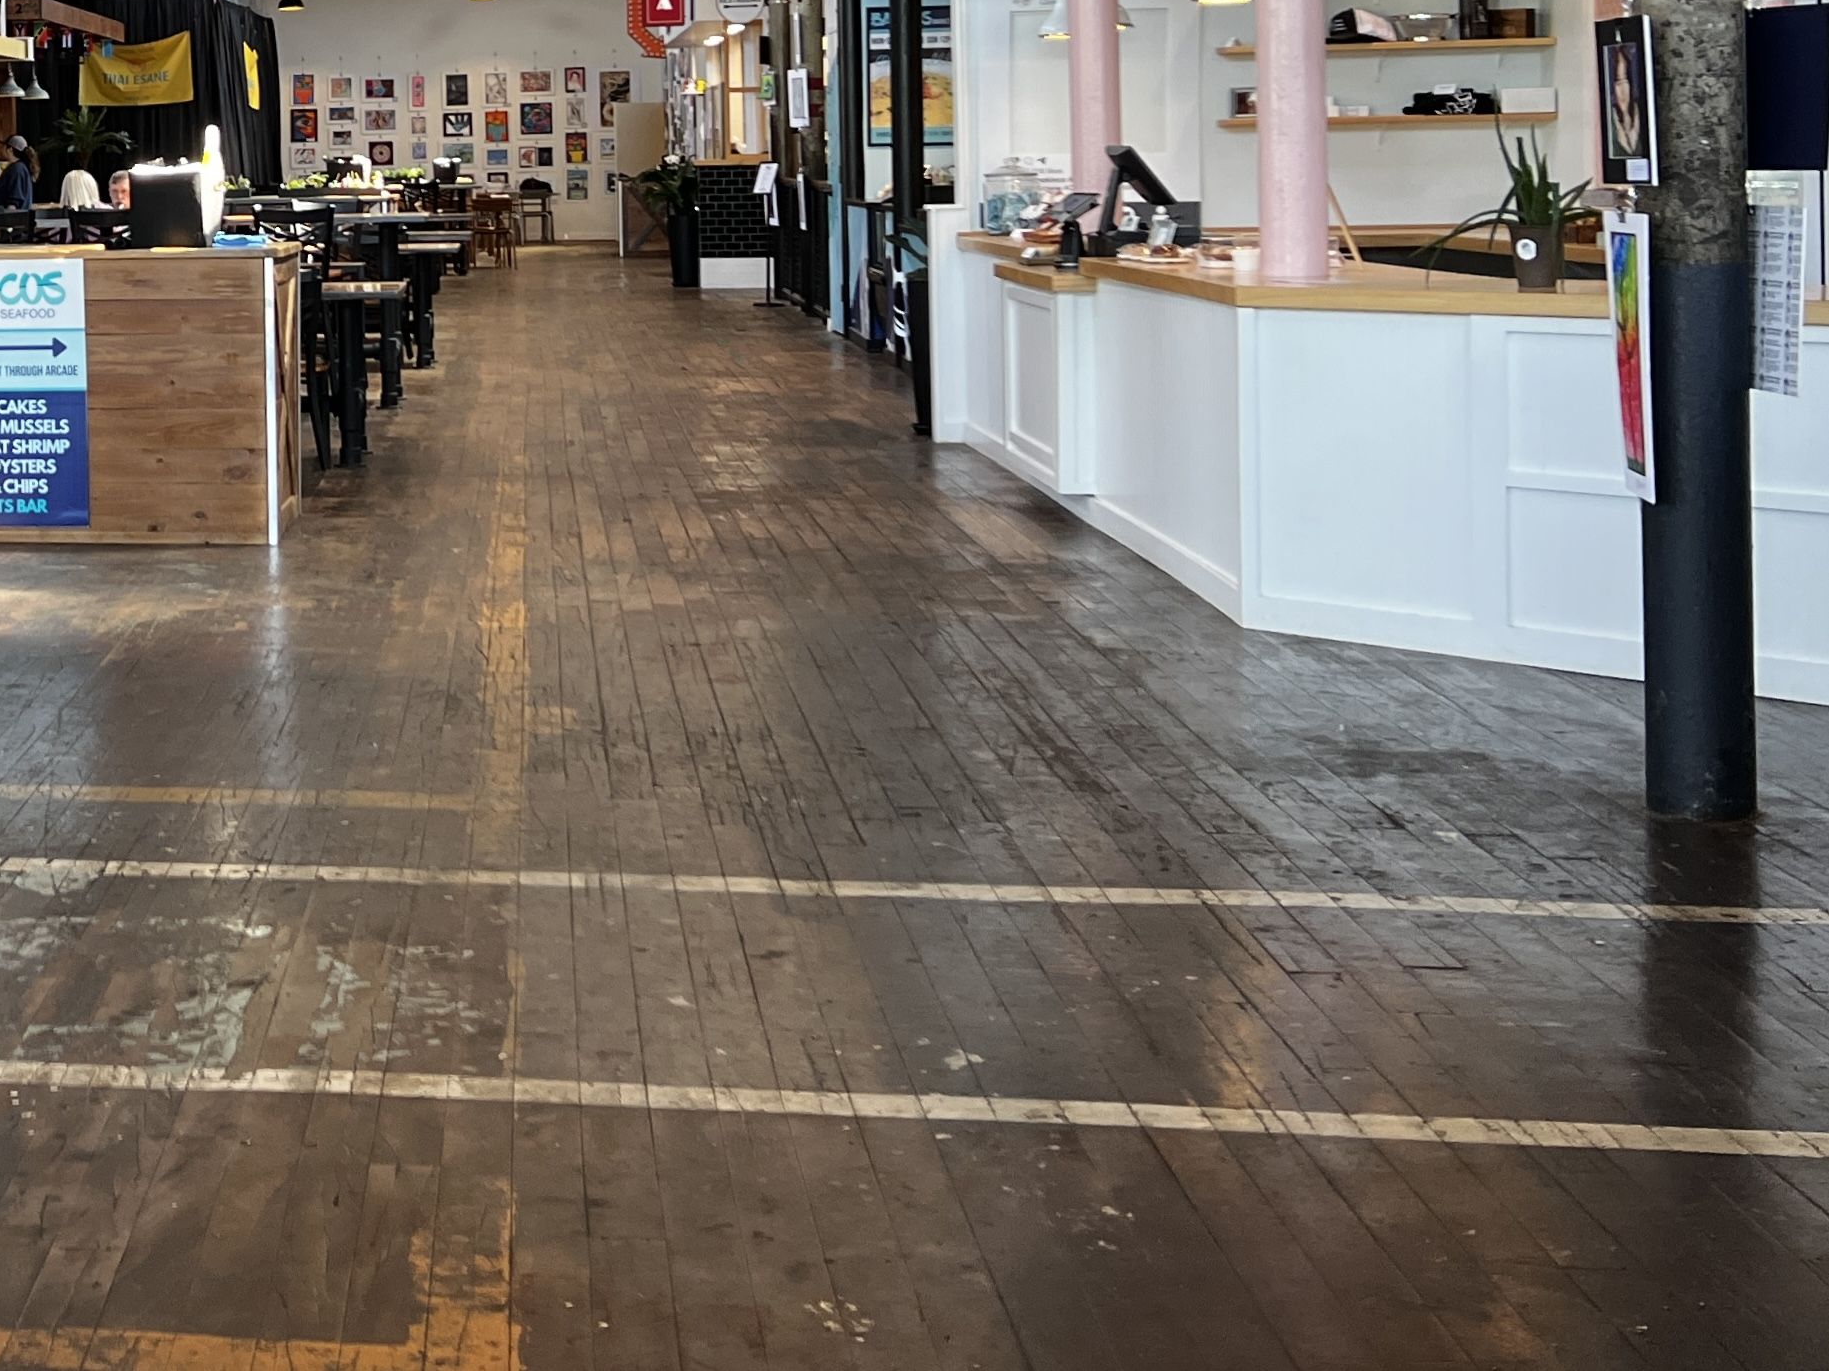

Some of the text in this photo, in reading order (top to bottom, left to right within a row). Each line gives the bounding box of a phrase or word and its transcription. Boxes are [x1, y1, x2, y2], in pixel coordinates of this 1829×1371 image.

[133, 70, 170, 85] ESANE
[0, 308, 56, 319] SEAFOOD
[4, 365, 43, 376] THROUGH
[45, 364, 78, 376] ARCADE
[0, 419, 70, 434] MUSSELS
[11, 439, 70, 454] SHRIMP
[3, 479, 49, 494] CHIPS
[16, 499, 48, 513] BAR
